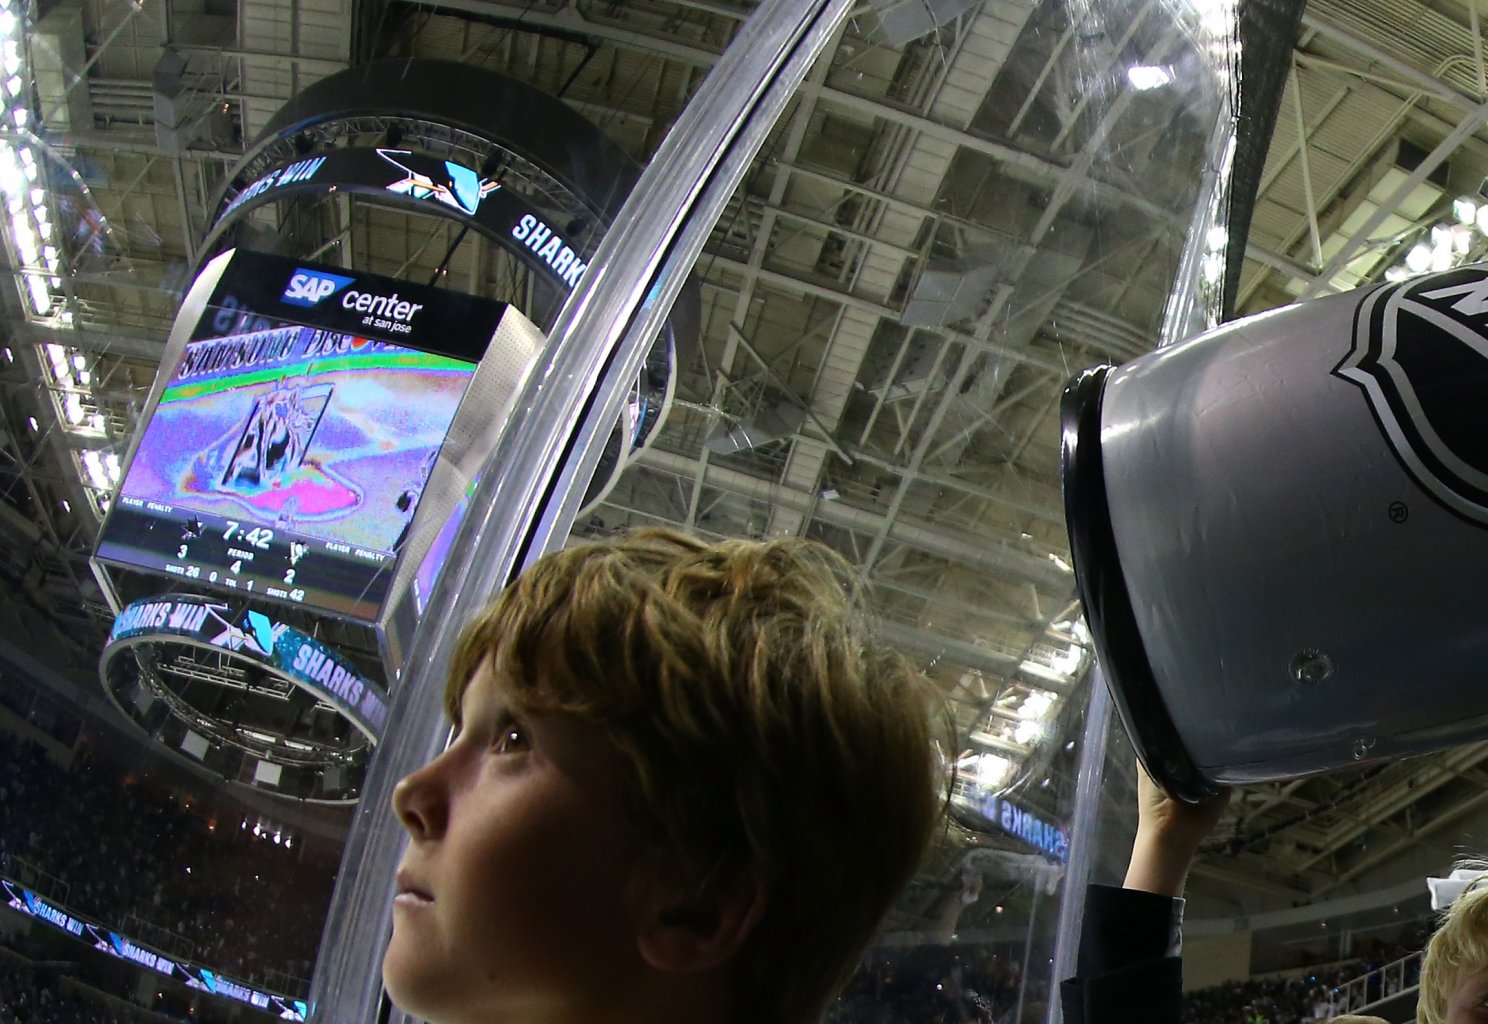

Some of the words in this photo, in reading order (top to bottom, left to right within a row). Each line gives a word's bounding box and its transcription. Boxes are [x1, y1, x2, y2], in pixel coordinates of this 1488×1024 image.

[512, 214, 588, 288] SHARK
[285, 274, 336, 302] SAP
[342, 290, 423, 322] center
[362, 315, 374, 326] at
[373, 318, 394, 330] san
[390, 319, 412, 334] jose
[222, 521, 273, 549] 7:42
[177, 545, 188, 559] 3
[227, 548, 254, 560] PERIOD
[284, 569, 296, 584] 2
[230, 561, 242, 574] 4
[288, 588, 305, 601] 42
[293, 644, 364, 709] SHARKS
[35, 901, 68, 927] SHARKS
